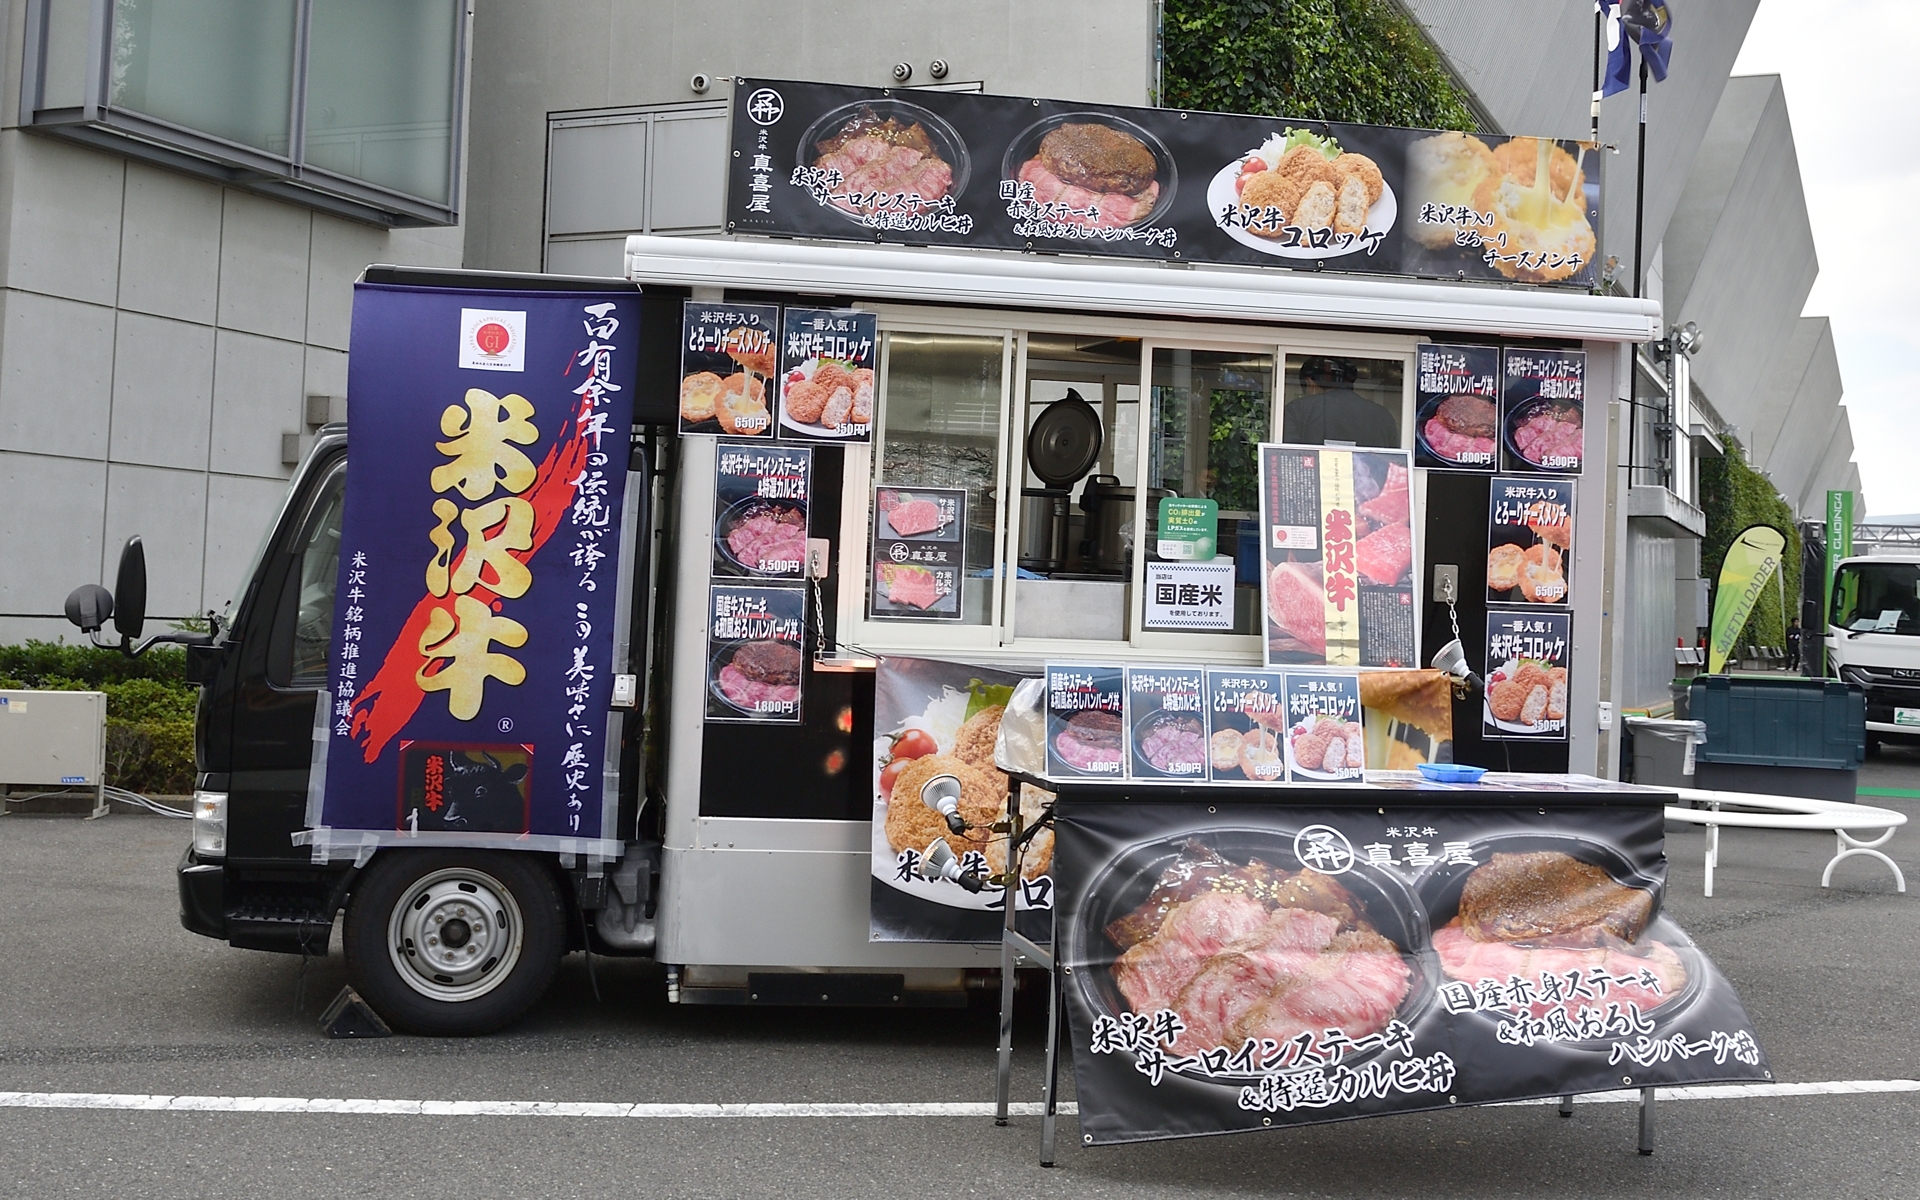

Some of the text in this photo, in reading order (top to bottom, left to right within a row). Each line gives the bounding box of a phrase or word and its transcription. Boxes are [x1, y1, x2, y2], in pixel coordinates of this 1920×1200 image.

[758, 128, 769, 150] 米沢牛
[745, 153, 774, 214] 真喜屋
[790, 165, 844, 189] 米沢牛
[812, 187, 957, 213] サーロインステーキ
[999, 180, 1035, 201] 国産
[1006, 200, 1100, 222] 赤身ステーキ
[1217, 202, 1285, 231] 米沢牛
[1418, 201, 1495, 227] 米沢牛入り
[1280, 225, 1386, 256] コロッケ
[1482, 248, 1583, 272] チーズメンチ
[700, 310, 760, 325] 米沢牛入り
[485, 335, 499, 349] GI
[688, 325, 771, 355] とろーりチーズメンチ
[787, 332, 872, 361] 米沢牛コロッケ
[1420, 353, 1466, 375] 国産牛ステーキ
[1507, 356, 1582, 380] 米沢牛サーロインステーキ
[734, 416, 767, 430] 650円
[834, 423, 866, 437] 350円
[720, 452, 806, 478] 米沢牛サーロインステーキ
[1455, 452, 1491, 465] 1,800円
[1541, 455, 1579, 468] 3,500円
[1504, 486, 1557, 500] 米沢牛入り
[938, 498, 947, 537] サーロイン
[946, 498, 956, 522] 米沢牛
[1494, 500, 1567, 527] とろーりチーズメンチ
[1833, 492, 1843, 550] GLIDING4
[416, 387, 540, 721] 米沢牛
[758, 559, 800, 573] 3,500円
[910, 550, 947, 562] 真喜屋
[1325, 508, 1356, 612] 米沢牛
[935, 571, 944, 596] カルビ
[943, 571, 953, 596] 米沢牛
[1155, 583, 1223, 607] 国産米
[1535, 586, 1564, 598] 650円
[715, 595, 767, 618] 国産牛ステーキ
[1716, 604, 1747, 659] SAFETY
[1742, 555, 1776, 614] LOADER
[334, 551, 369, 736] 米沢牛銘柄推進協議会
[1490, 633, 1565, 660] 米沢牛コロッケ
[1050, 672, 1094, 692] 国産牛ステーキ
[1131, 673, 1200, 694] 米沢牛サーロインステーキ
[1221, 678, 1269, 690] 米沢牛入り
[754, 701, 794, 714] 1,800円
[1213, 690, 1279, 714] とろーりチーズメンチ
[1290, 694, 1356, 717] 米沢牛コロッケ
[1086, 761, 1120, 773] 1,800円
[1168, 762, 1202, 774] 3,500円
[1255, 765, 1281, 777] 650円
[425, 754, 444, 812] 米沢牛
[1385, 826, 1439, 839] 米沢牛
[893, 848, 992, 883] 米牛
[1363, 841, 1478, 868] 真喜屋
[1438, 966, 1661, 1015] 国産赤身ステーキ
[1090, 1010, 1186, 1054] 米沢牛
[1497, 1001, 1656, 1047] &和風おろし
[1135, 1020, 1416, 1085] サーロインステーキ
[1608, 1029, 1759, 1066] ハンバーグ丼
